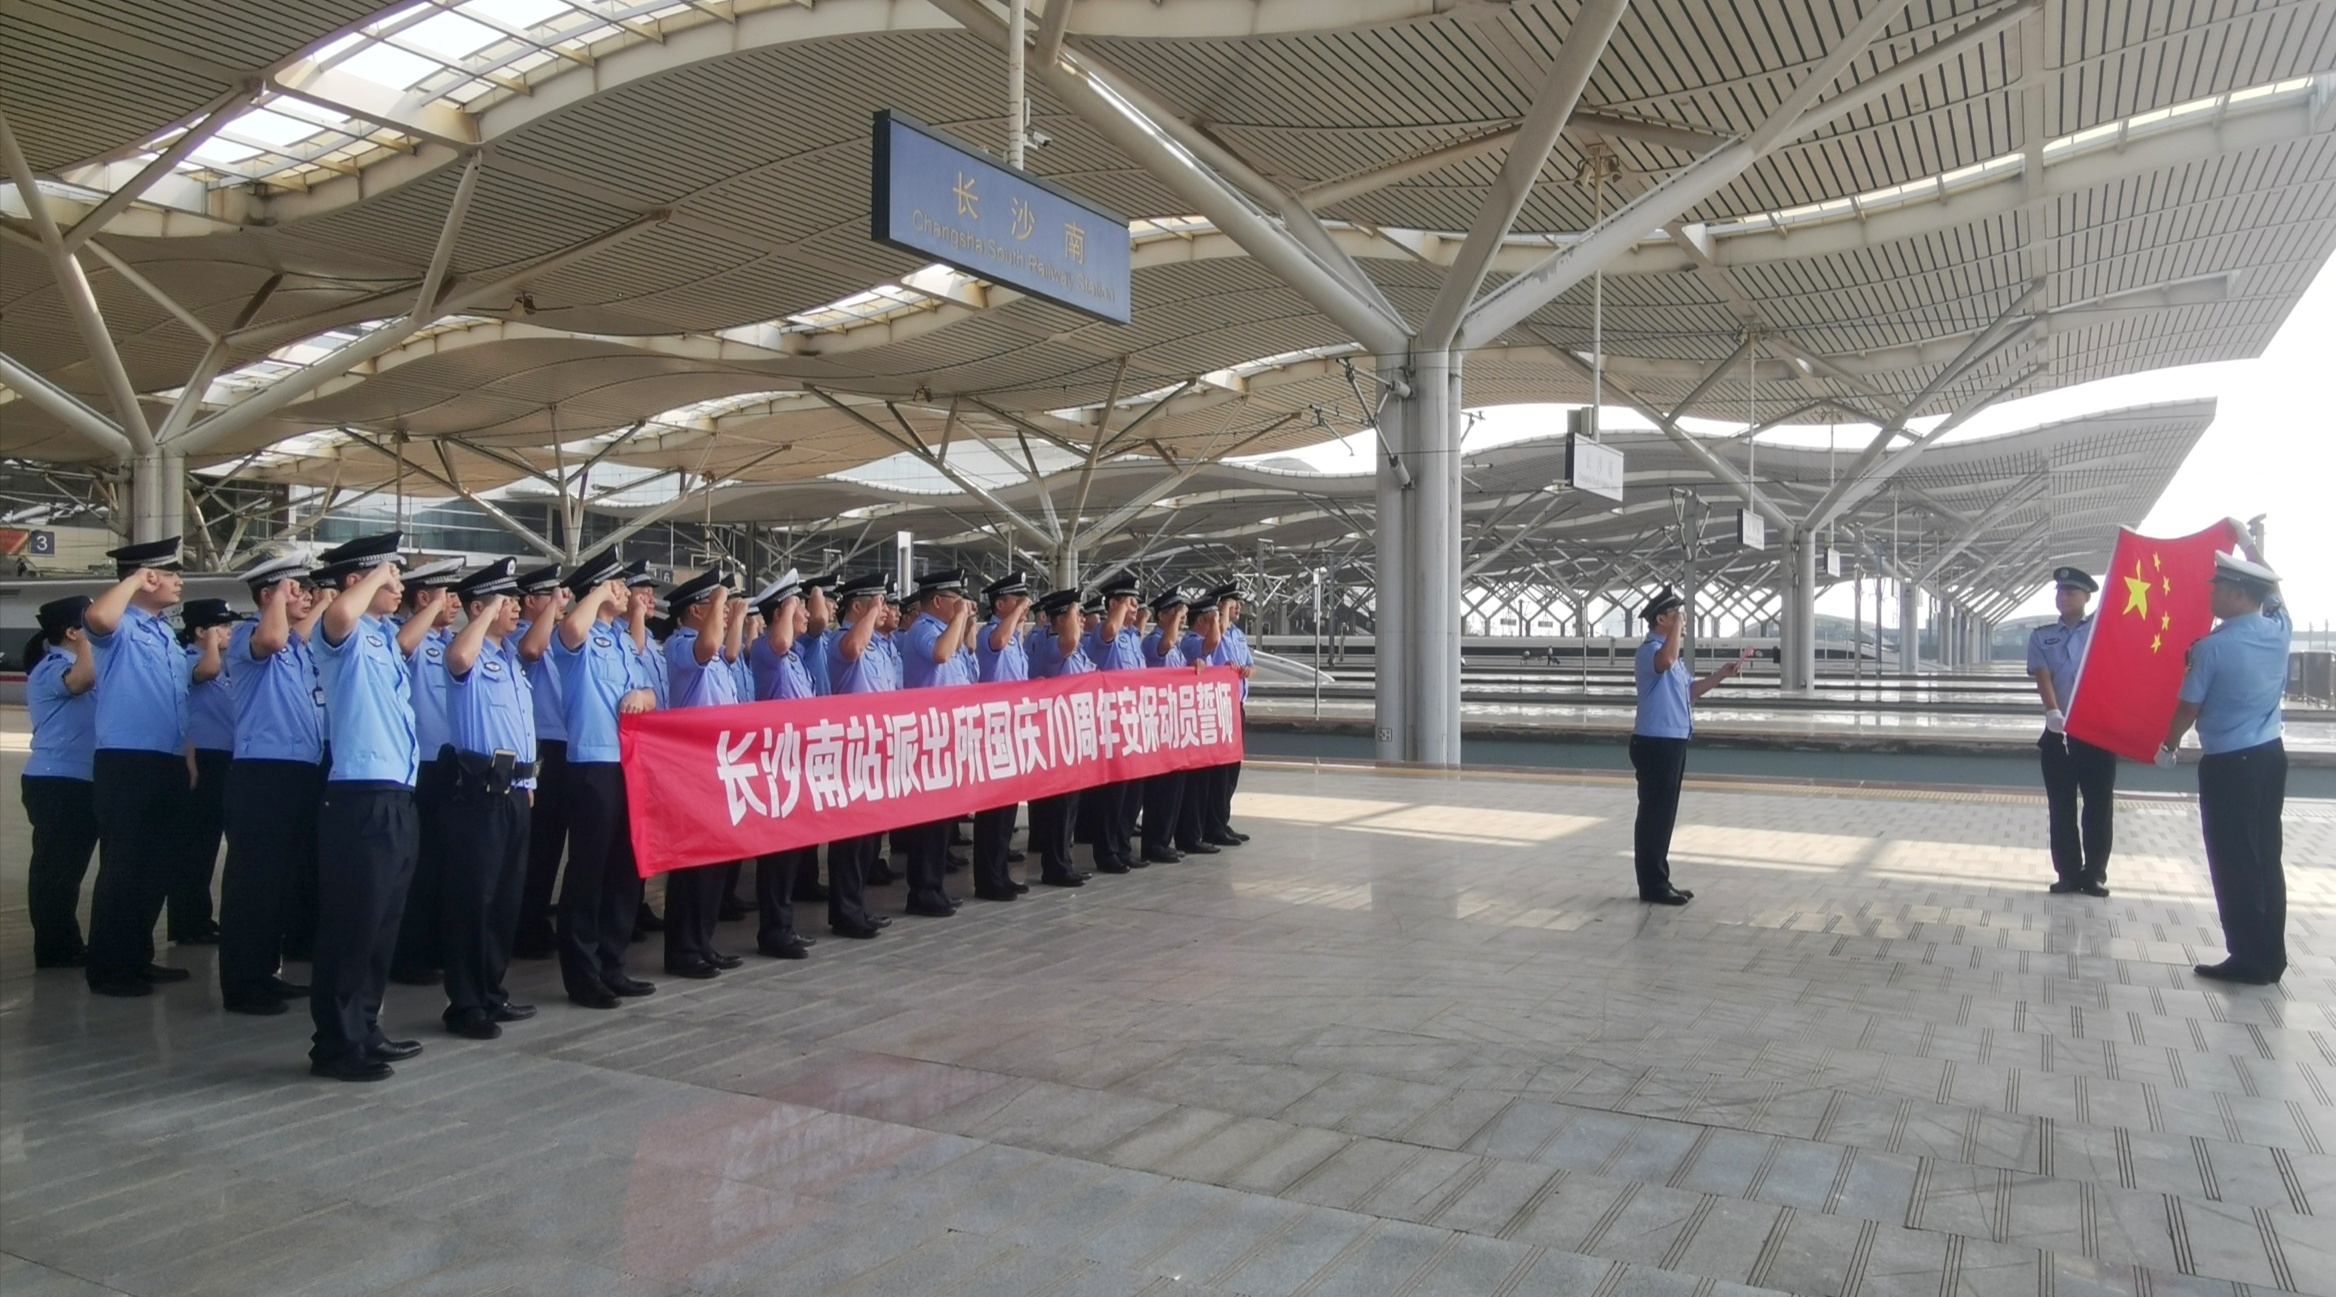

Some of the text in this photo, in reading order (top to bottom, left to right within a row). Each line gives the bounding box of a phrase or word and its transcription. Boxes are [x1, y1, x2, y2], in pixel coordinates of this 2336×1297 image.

[912, 210, 1116, 303] Changsha South Railway Station
[953, 171, 1086, 265] 长沙南
[37, 535, 48, 551] 3
[716, 681, 1233, 826] 长沙南站派出所国庆70周年安保动员誓师
